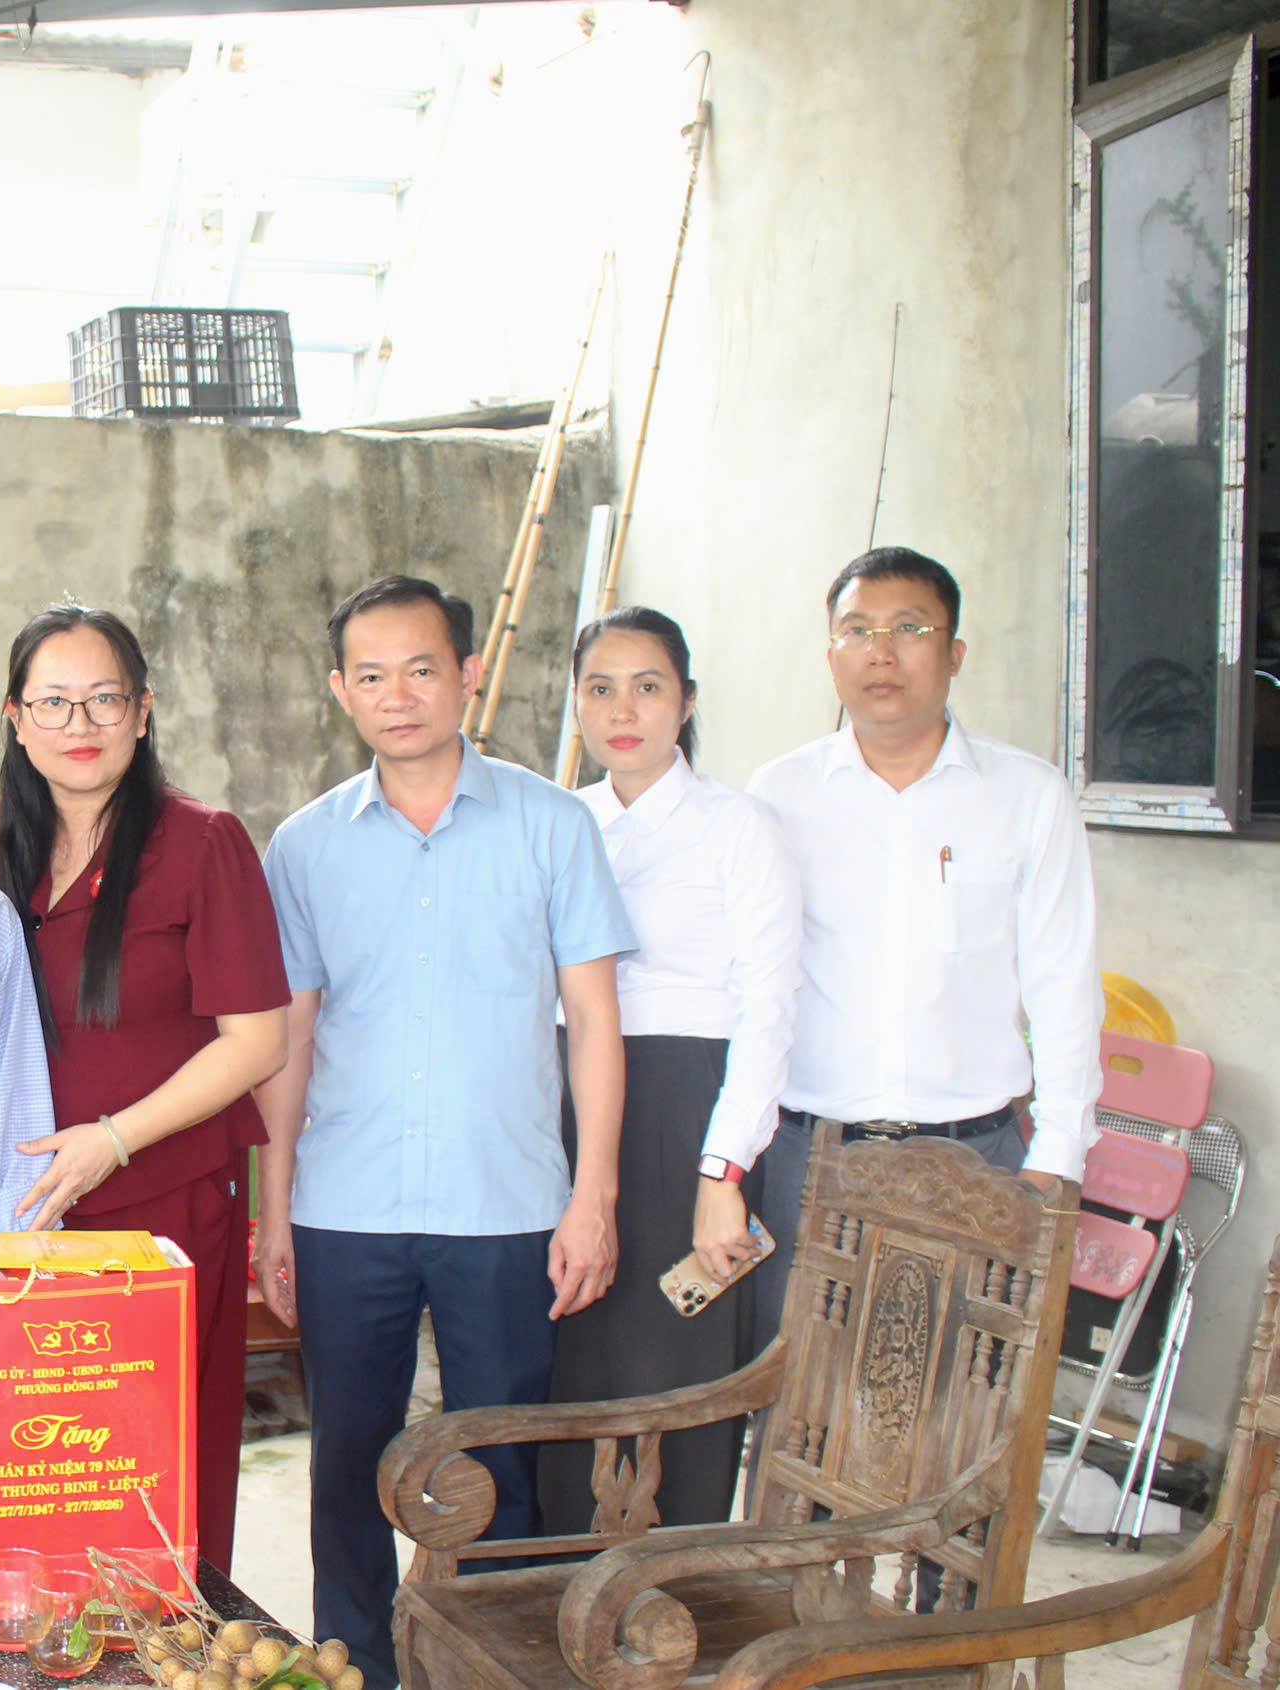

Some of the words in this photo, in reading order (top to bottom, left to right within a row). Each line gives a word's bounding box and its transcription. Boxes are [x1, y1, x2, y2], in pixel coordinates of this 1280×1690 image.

[73, 1365, 103, 1376] UBND
[111, 1360, 155, 1373] UBMTTQ
[15, 1382, 61, 1395] PHƯỜNG
[96, 1378, 119, 1390] SƠN
[11, 1413, 111, 1454] Tặng
[49, 1459, 86, 1477] NIỆM
[88, 1461, 103, 1473] 79
[105, 1456, 137, 1472] NĂM
[0, 1482, 61, 1498] THƯƠNG
[63, 1480, 99, 1494] BINH
[108, 1475, 140, 1492] LIỆT
